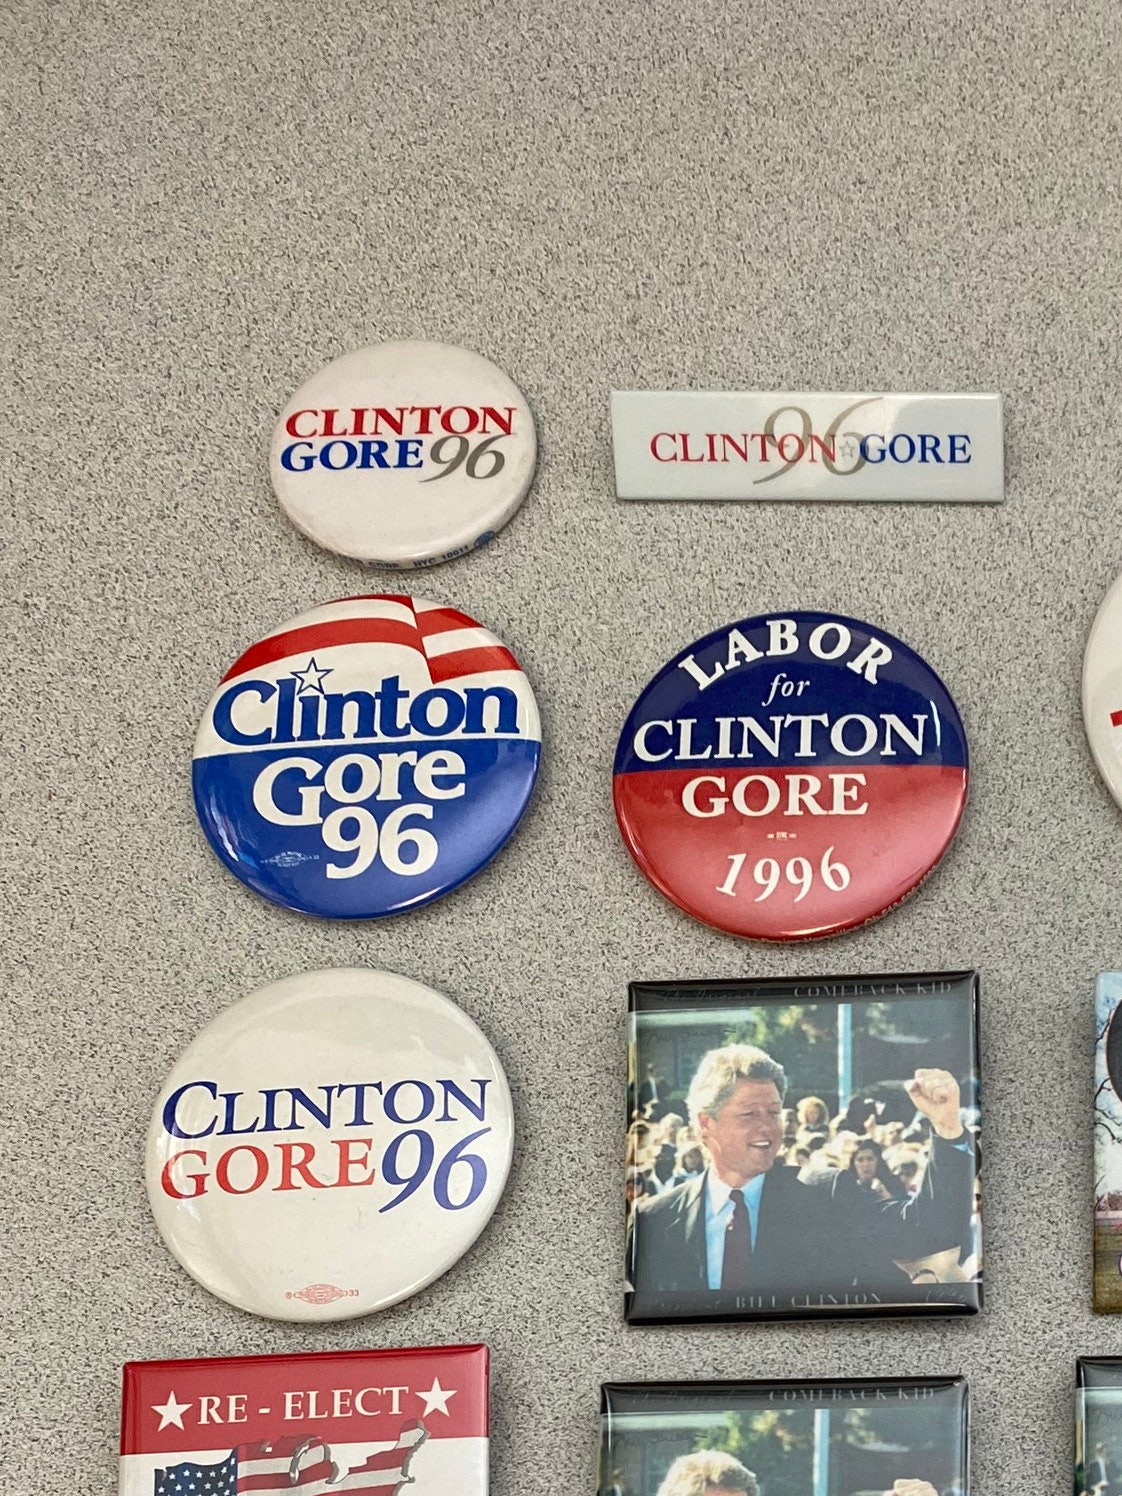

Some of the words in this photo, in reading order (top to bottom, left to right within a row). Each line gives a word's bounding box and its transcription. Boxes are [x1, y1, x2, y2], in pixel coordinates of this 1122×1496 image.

[285, 405, 517, 438] CLINTON
[753, 396, 884, 485] 96
[281, 439, 424, 472] GORE
[418, 434, 517, 483] 96
[650, 432, 837, 463] CLINTON
[860, 434, 972, 464] GORE
[678, 619, 893, 691] LABOR
[212, 672, 520, 746] Clinton
[761, 673, 810, 706] for
[633, 713, 928, 762] CLINTON
[252, 750, 466, 826] Gore
[682, 773, 869, 818] GORE
[321, 803, 438, 879] 96
[716, 845, 851, 903] 1996
[794, 983, 907, 997] COMEBACK
[916, 981, 951, 995] KID
[161, 1078, 492, 1139] CLINTON
[160, 1138, 376, 1200] GORE
[378, 1126, 492, 1213] 96
[735, 1295, 777, 1309] BILL
[790, 1292, 882, 1308] CLINTON
[768, 1388, 888, 1401] COMEBACK
[898, 1387, 935, 1400] KID
